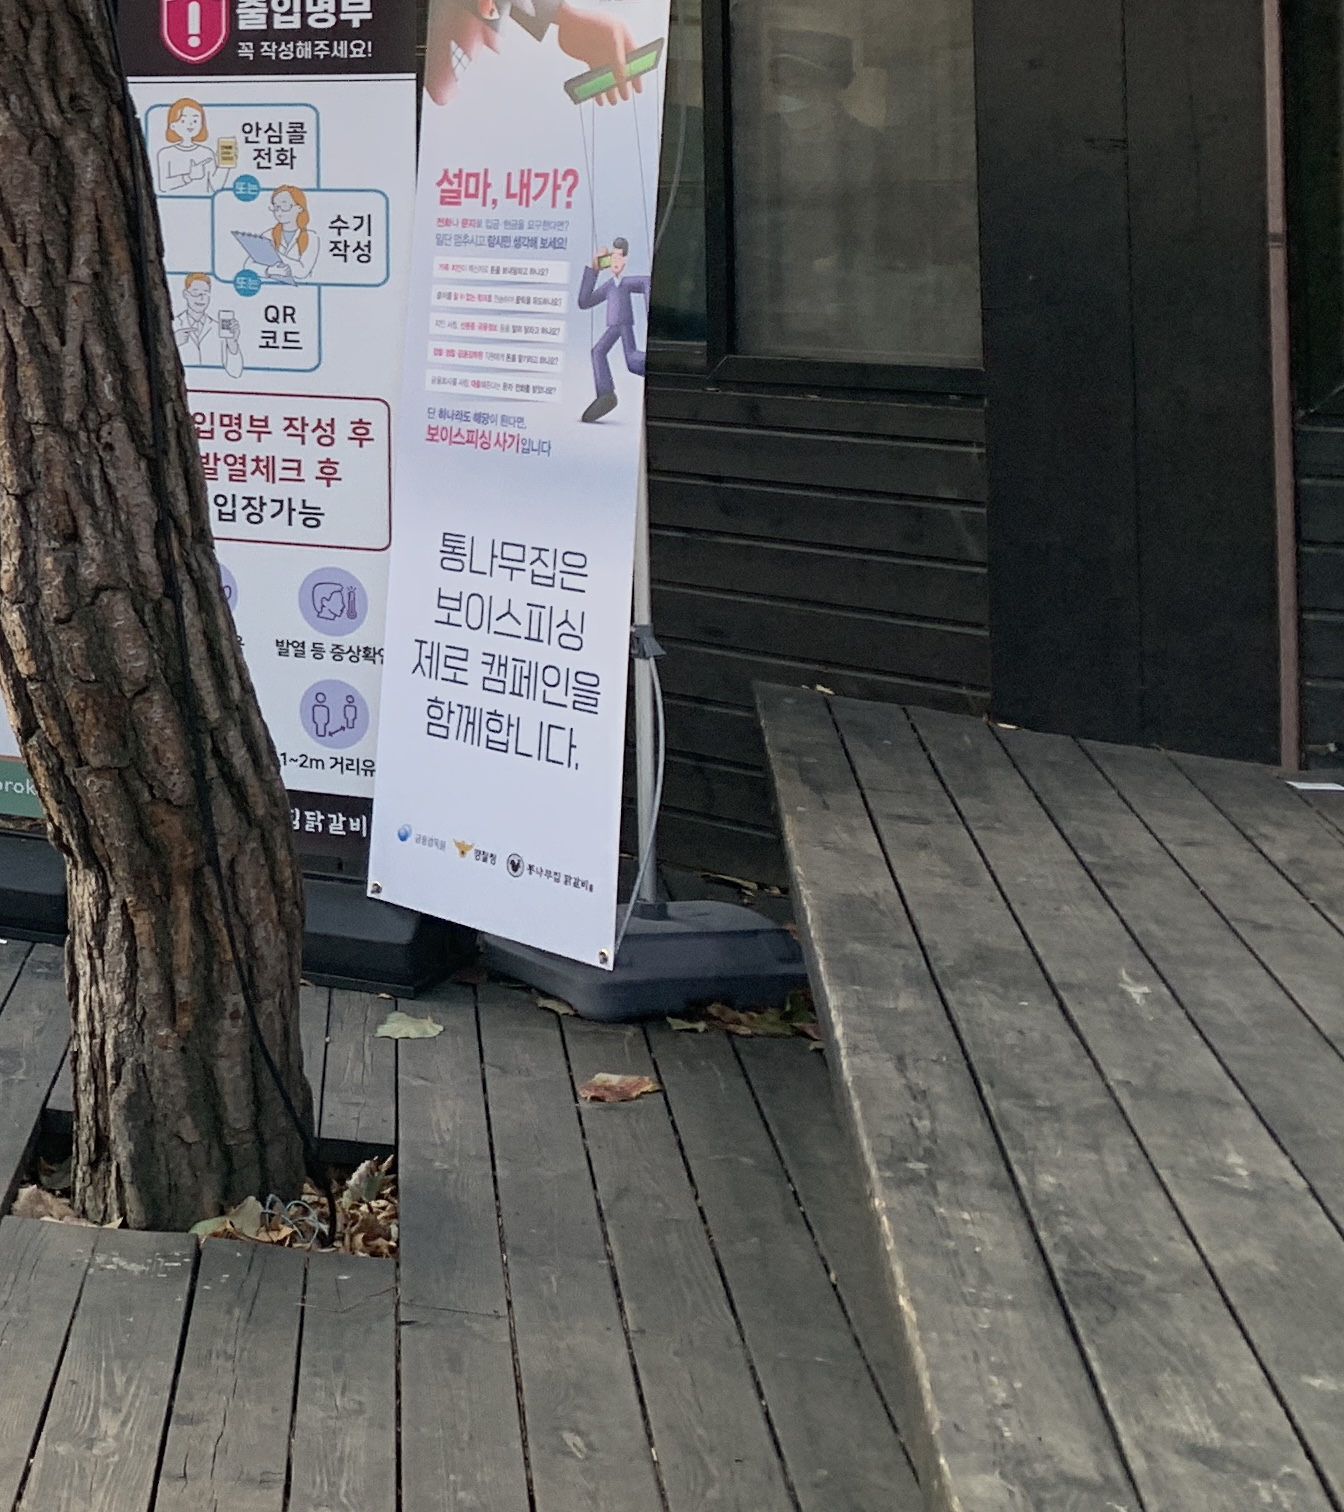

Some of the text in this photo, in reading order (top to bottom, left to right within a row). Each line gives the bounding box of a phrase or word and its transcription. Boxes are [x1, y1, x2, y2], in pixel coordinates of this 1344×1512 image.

[237, 39, 372, 60] 꼭 작성해주세요!
[242, 121, 307, 145] 안심콜
[253, 148, 296, 170] 전화
[436, 168, 579, 210] 설마, 내가?
[328, 213, 372, 237] 수기
[329, 239, 372, 264] 작성
[264, 304, 297, 326] QR
[259, 330, 303, 350] 코드
[282, 415, 336, 447] 작성
[347, 418, 374, 448] 후
[426, 424, 492, 450] 보이스피싱
[200, 452, 342, 488] 발열체크 후
[213, 493, 325, 529] 입장가능
[438, 532, 589, 594] 통나무집은
[434, 586, 586, 652] 보이스피싱
[275, 639, 306, 659] 발열
[310, 641, 326, 660] 등
[411, 638, 601, 716] 제로 캠페인을
[426, 695, 579, 770] 함께합니다.
